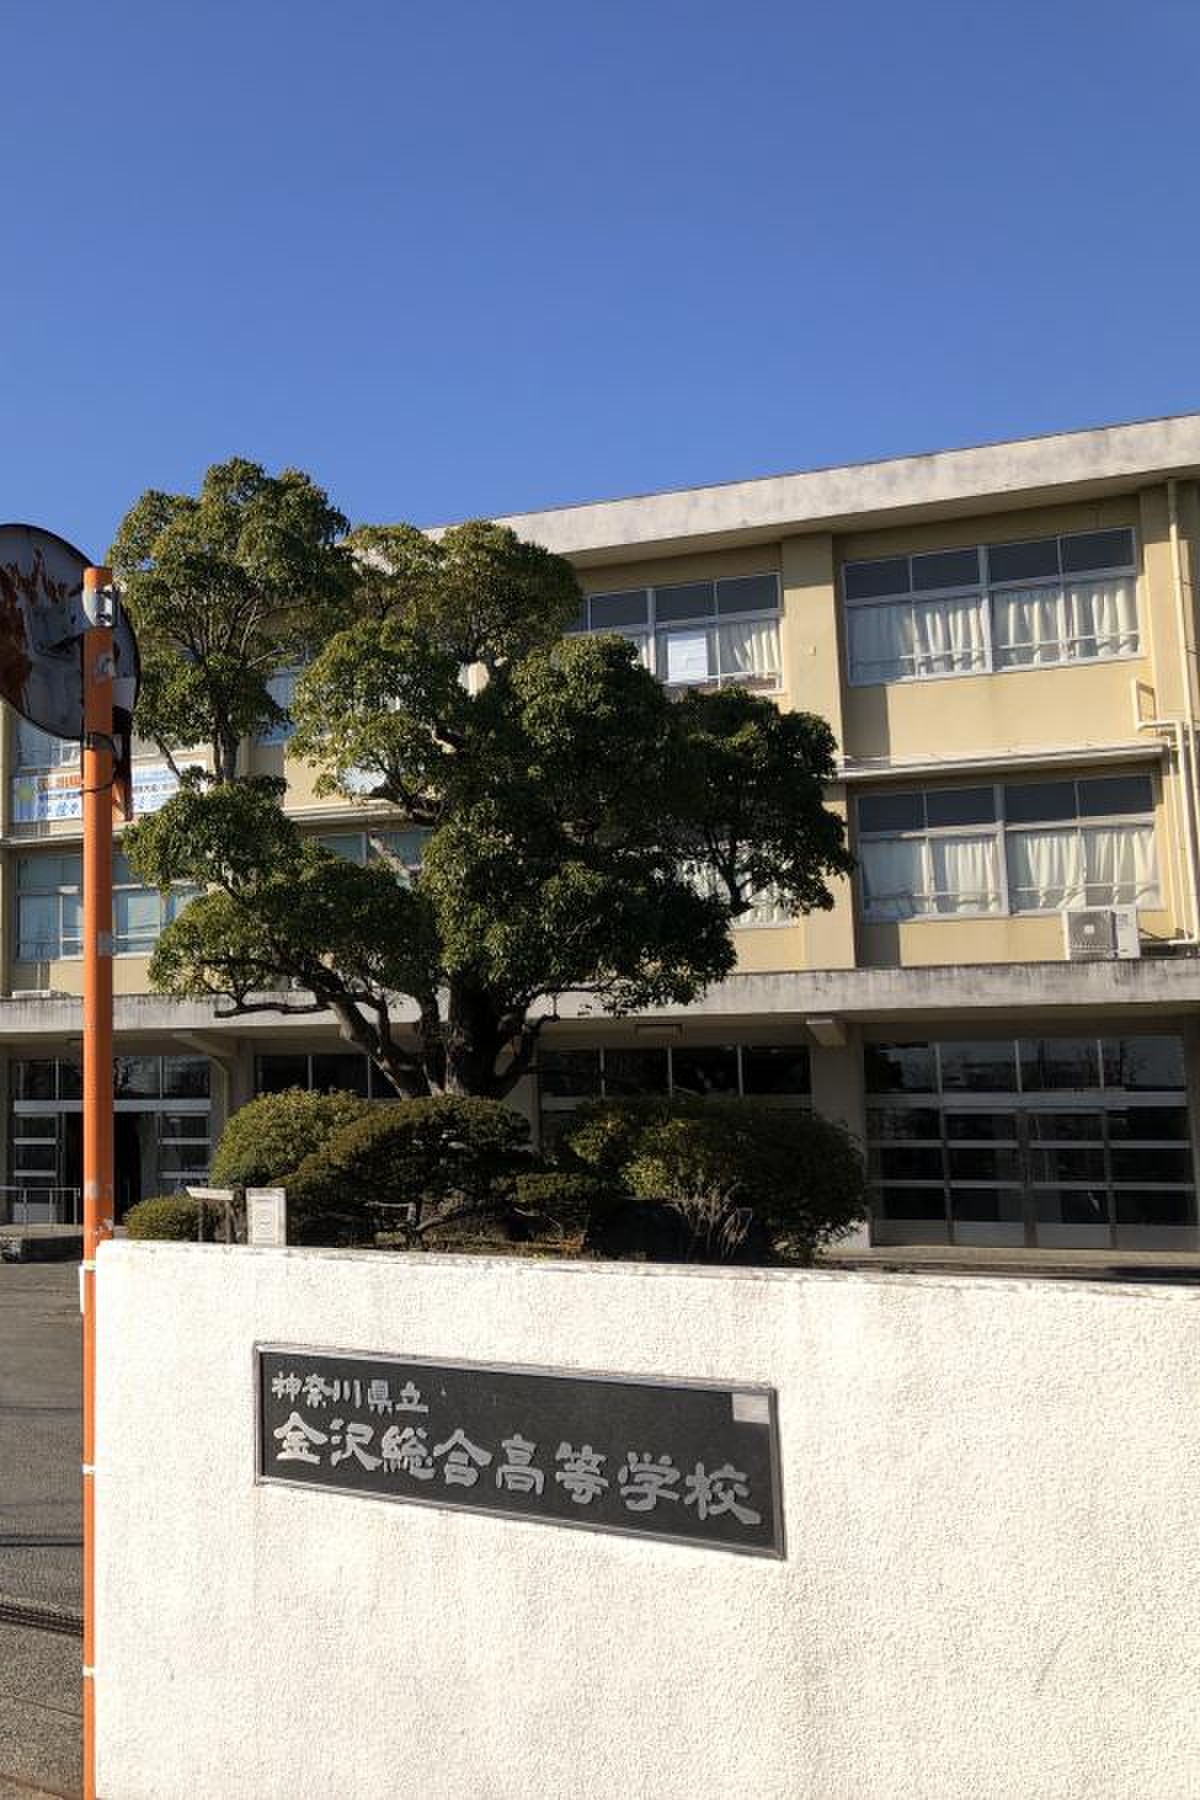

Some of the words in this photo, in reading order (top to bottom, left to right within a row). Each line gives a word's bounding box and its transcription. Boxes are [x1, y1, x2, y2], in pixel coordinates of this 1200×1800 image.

[272, 1371, 429, 1414] 神奈川県立
[273, 1411, 760, 1525] 金沢総合高等学校
